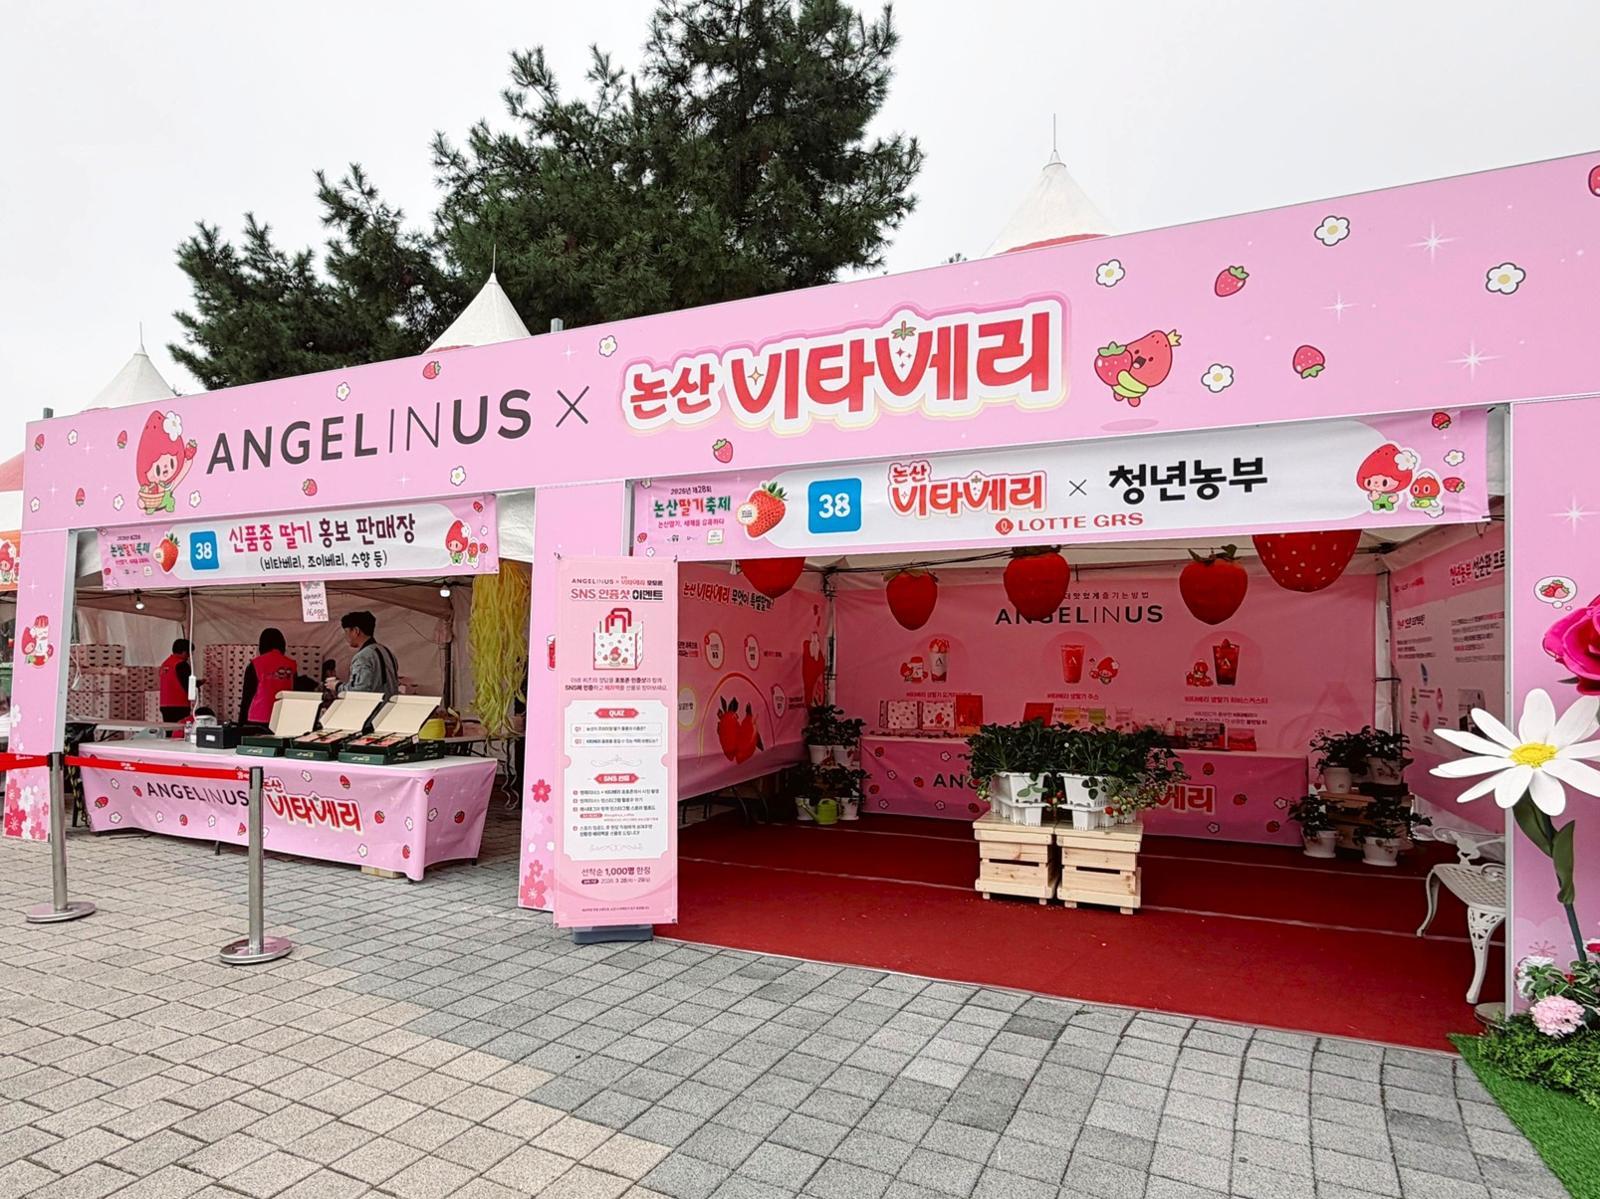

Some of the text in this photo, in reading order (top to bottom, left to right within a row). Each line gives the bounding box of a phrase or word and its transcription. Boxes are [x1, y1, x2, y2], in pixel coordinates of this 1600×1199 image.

[206, 388, 531, 474] ANGELINUS
[630, 362, 715, 420] 논산
[732, 312, 1049, 419] 비타베리
[893, 463, 928, 482] 논산
[894, 474, 1043, 516] 비타베리
[1109, 457, 1268, 505] 청년농부
[654, 495, 731, 518] 논산딸기축제
[819, 493, 850, 519] 38
[229, 513, 415, 553] 신품종 딸기 홍보 판매장
[1018, 513, 1144, 532] LOTTE GRS
[195, 542, 212, 560] 38
[260, 550, 387, 571] (비타베리, 조이베리, 수향 등)
[571, 588, 663, 601] SNS 인증샷 이벤트
[684, 582, 696, 597] 논산
[732, 588, 749, 607] 무엇이
[608, 709, 625, 718] QUIZ
[147, 782, 249, 807] ANGELINUS
[266, 794, 361, 832] 비타베리
[581, 866, 651, 877] 선착순 1,000명 한정
